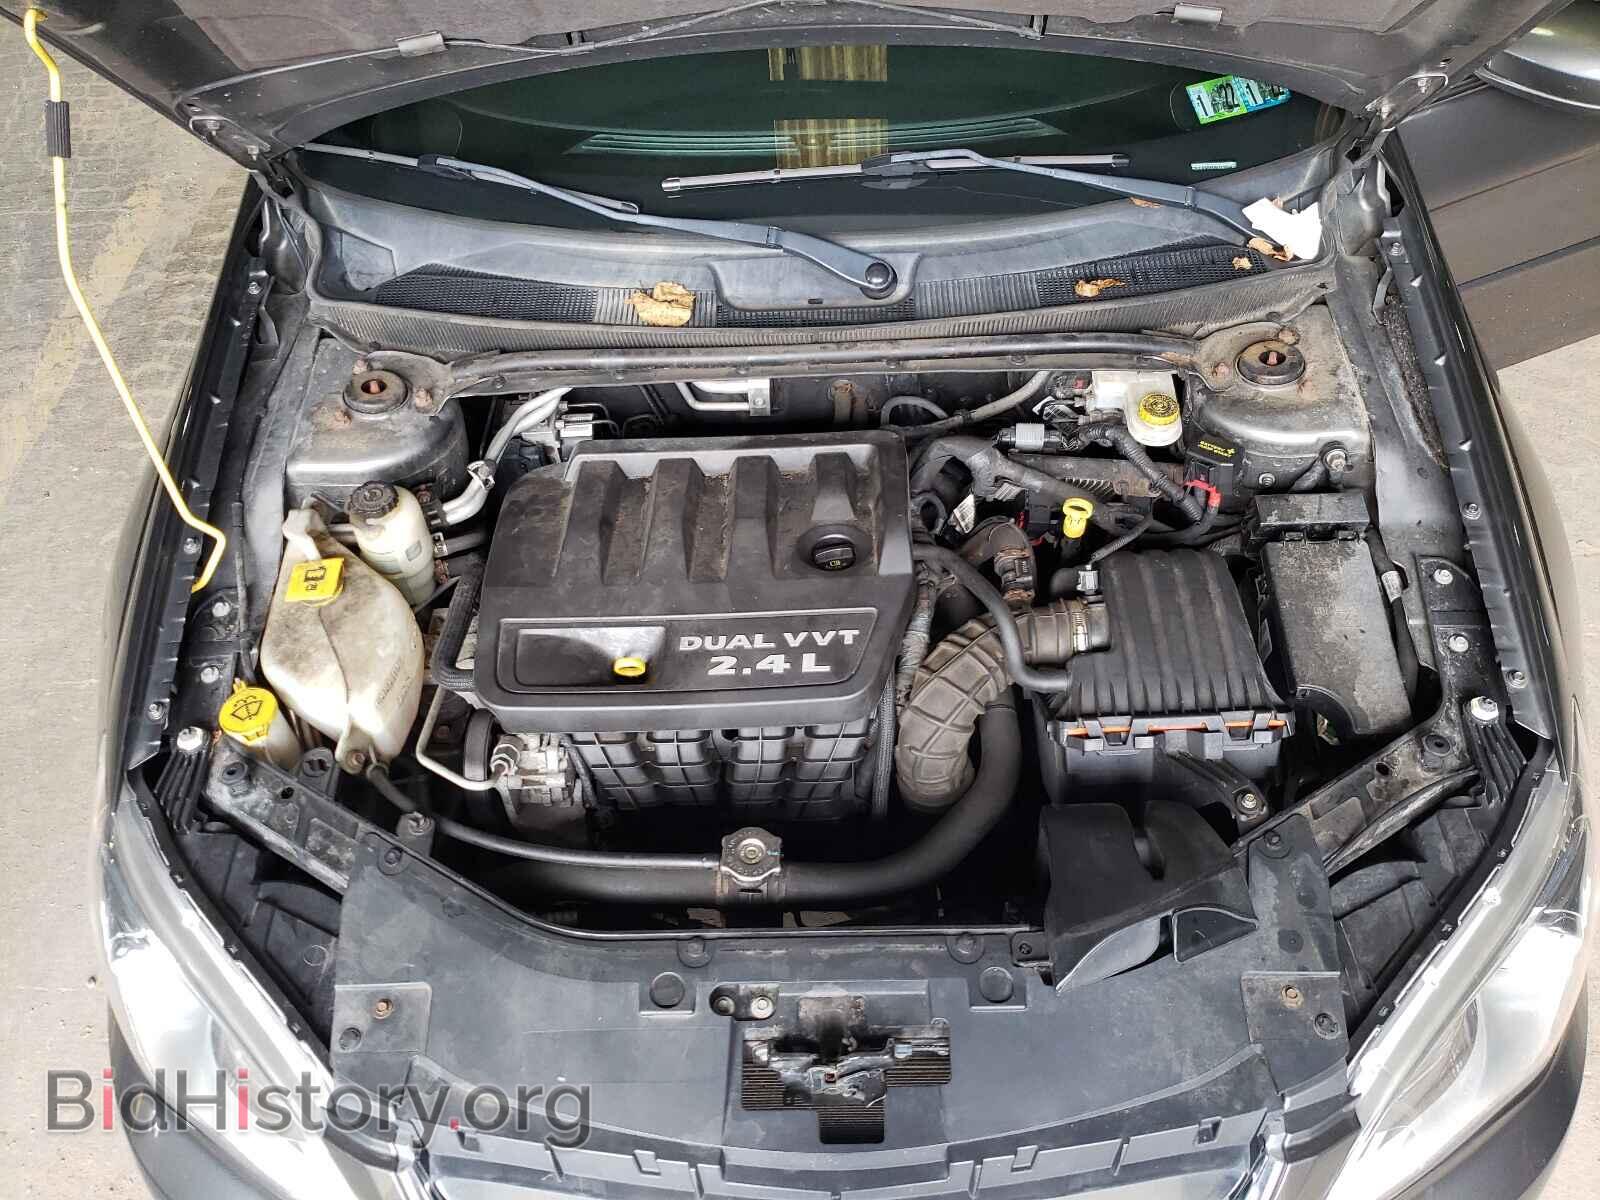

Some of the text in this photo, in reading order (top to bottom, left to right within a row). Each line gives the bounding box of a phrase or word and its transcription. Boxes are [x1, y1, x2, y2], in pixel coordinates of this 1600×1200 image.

[1195, 82, 1241, 117] 1 22
[1246, 82, 1259, 105] 1
[679, 629, 861, 651] DUAL VVT
[707, 652, 832, 677] 2.4 L
